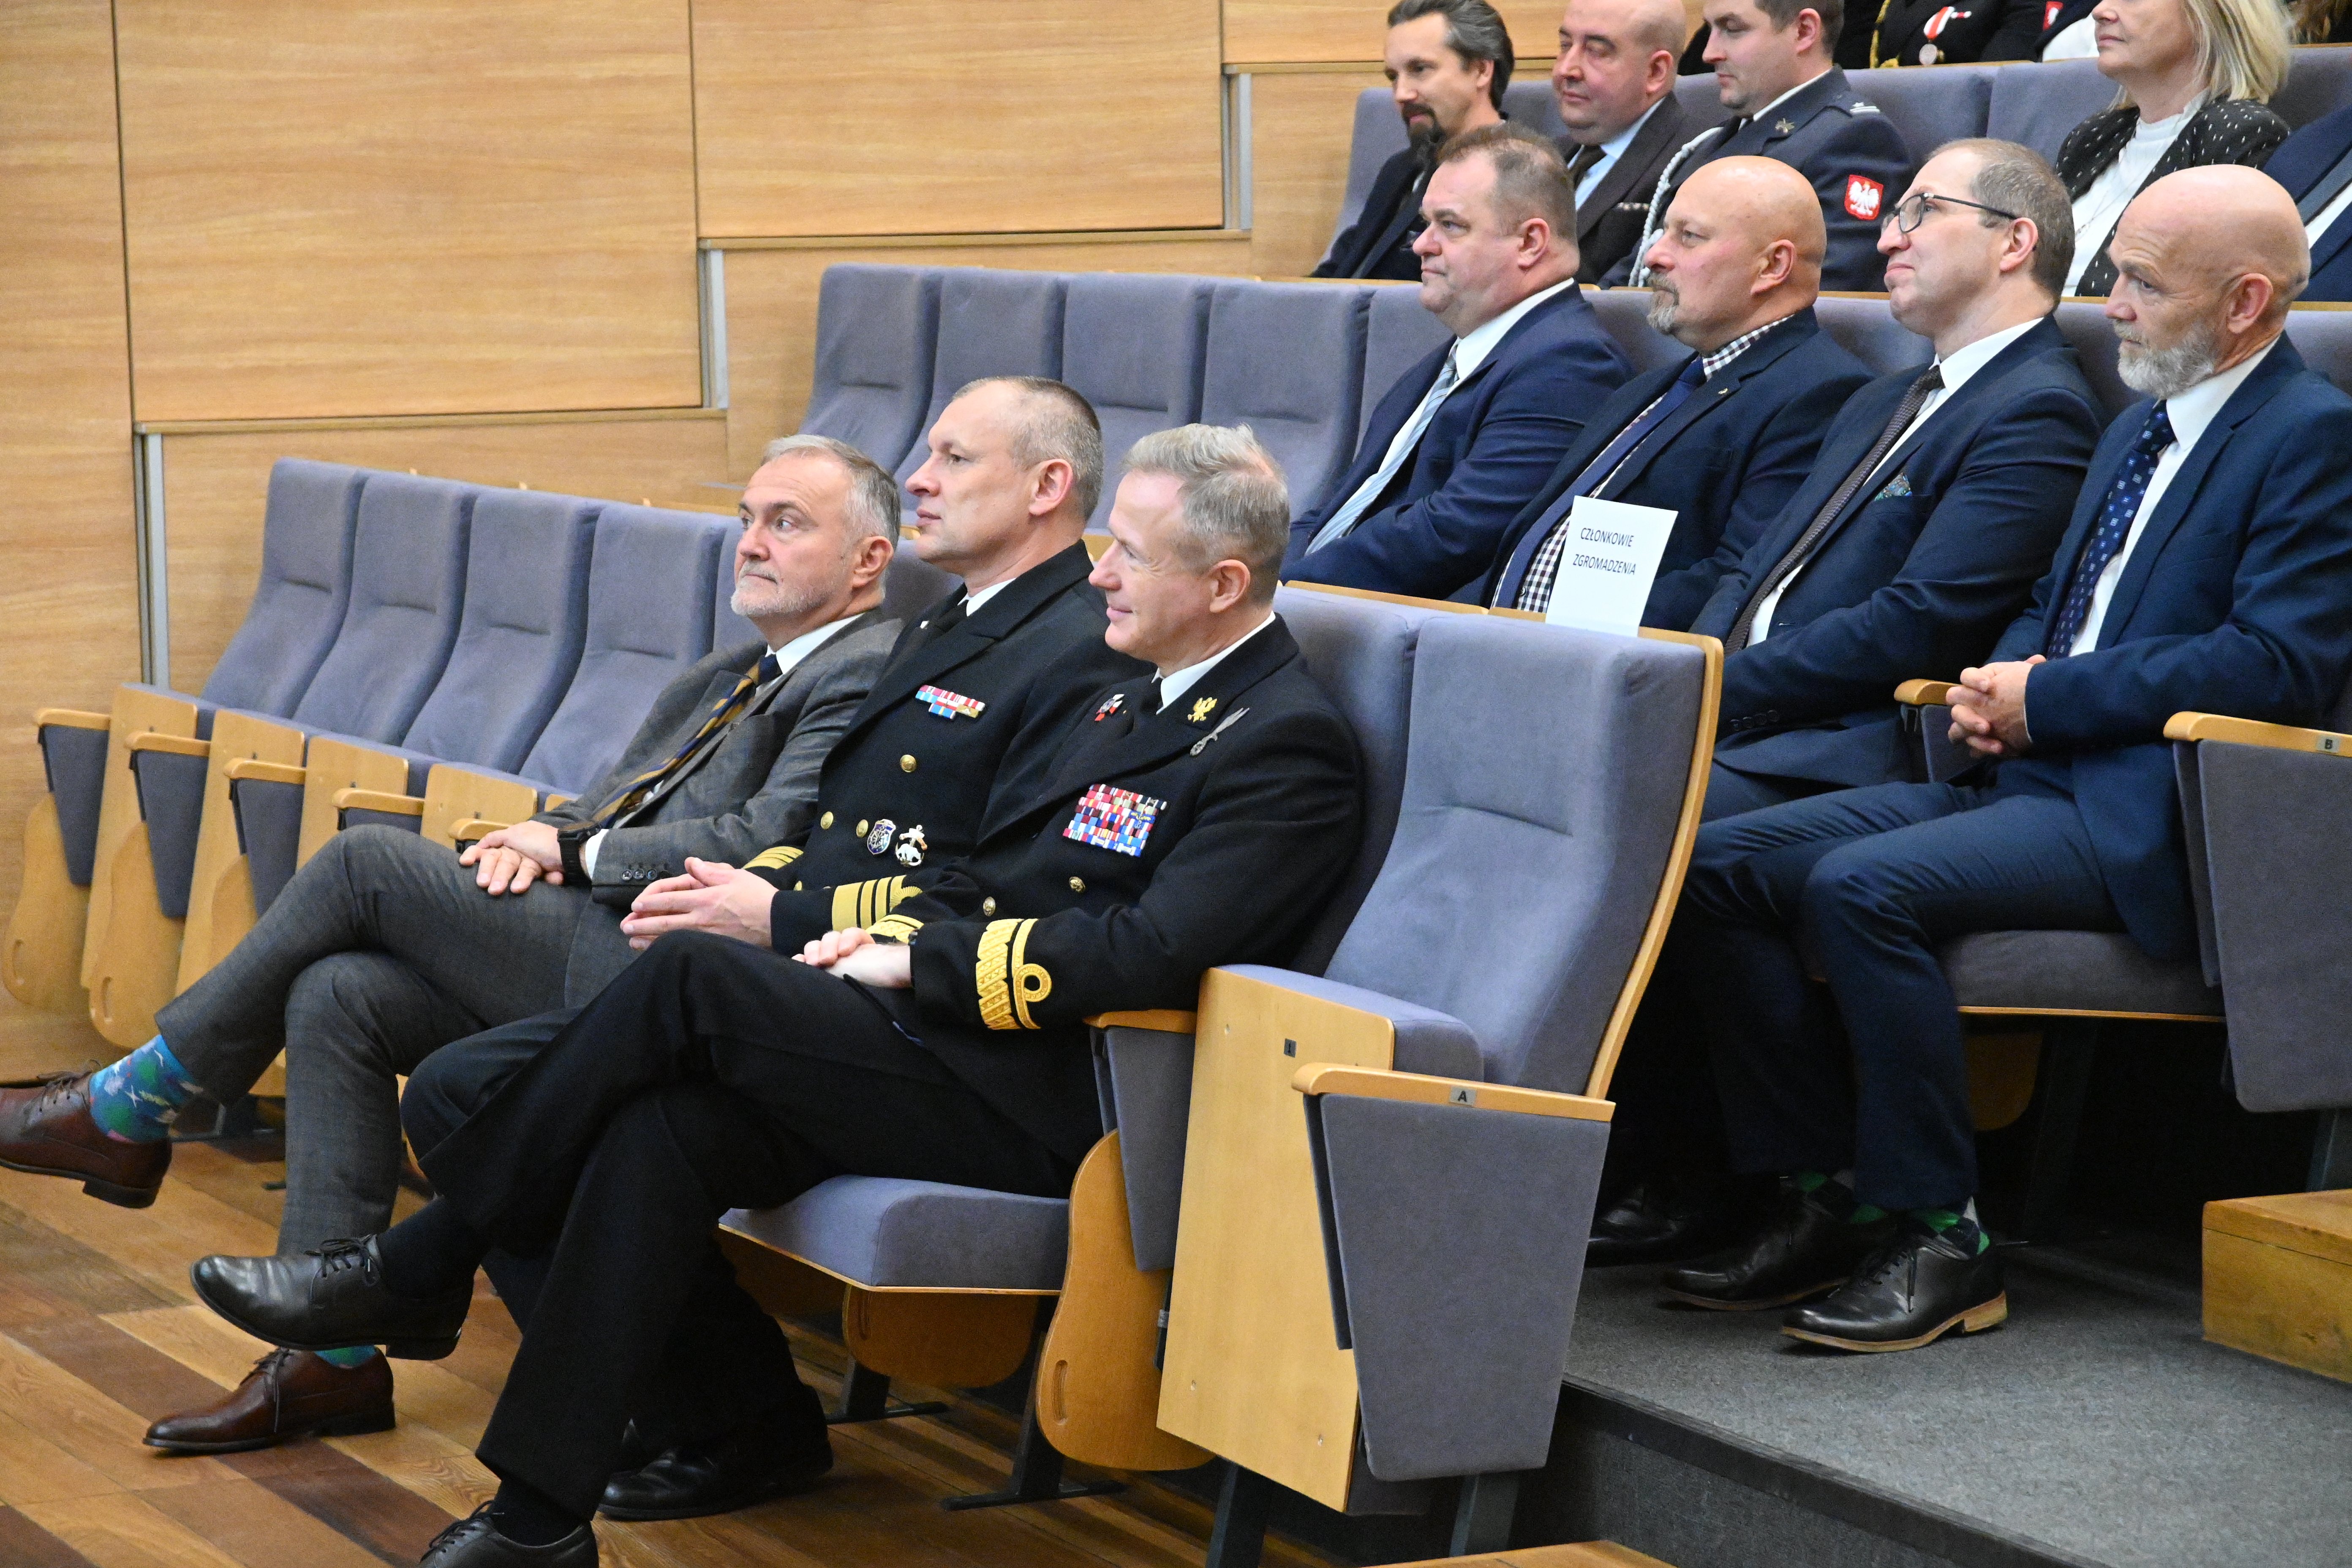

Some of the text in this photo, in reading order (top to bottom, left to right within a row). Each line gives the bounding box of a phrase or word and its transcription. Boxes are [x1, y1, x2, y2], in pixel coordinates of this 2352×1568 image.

[1581, 528, 1634, 547] CZŁONKOWIE
[1573, 554, 1636, 575] ZGROMADZENIA
[2325, 739, 2333, 749] B
[1457, 1090, 1467, 1102] A
